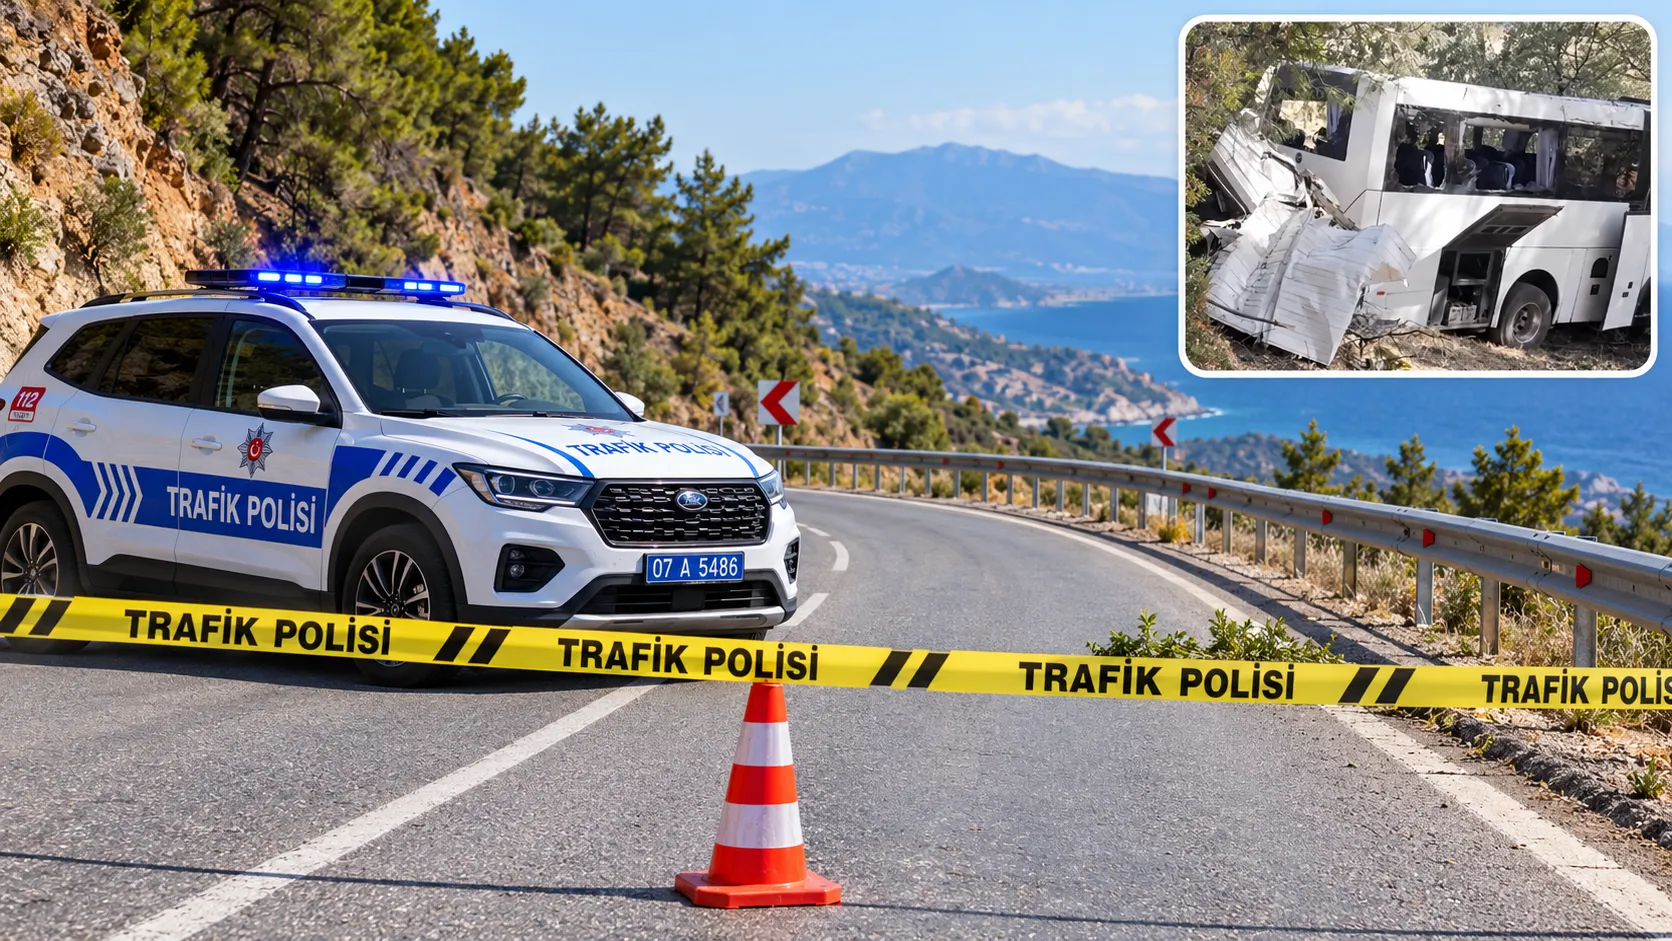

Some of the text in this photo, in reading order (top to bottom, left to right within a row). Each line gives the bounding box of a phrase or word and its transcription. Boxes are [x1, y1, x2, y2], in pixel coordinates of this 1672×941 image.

[16, 391, 39, 408] 112
[166, 485, 316, 534] TRAFİK POLİSİ
[652, 556, 738, 578] 07 A 5486
[124, 608, 391, 655] TRAFİK POLİSİ
[558, 636, 818, 681] TRAFİK POLİSİ
[1019, 658, 1295, 700] TRAFİK POLİSİ
[1481, 668, 1590, 704] TRAFİK
